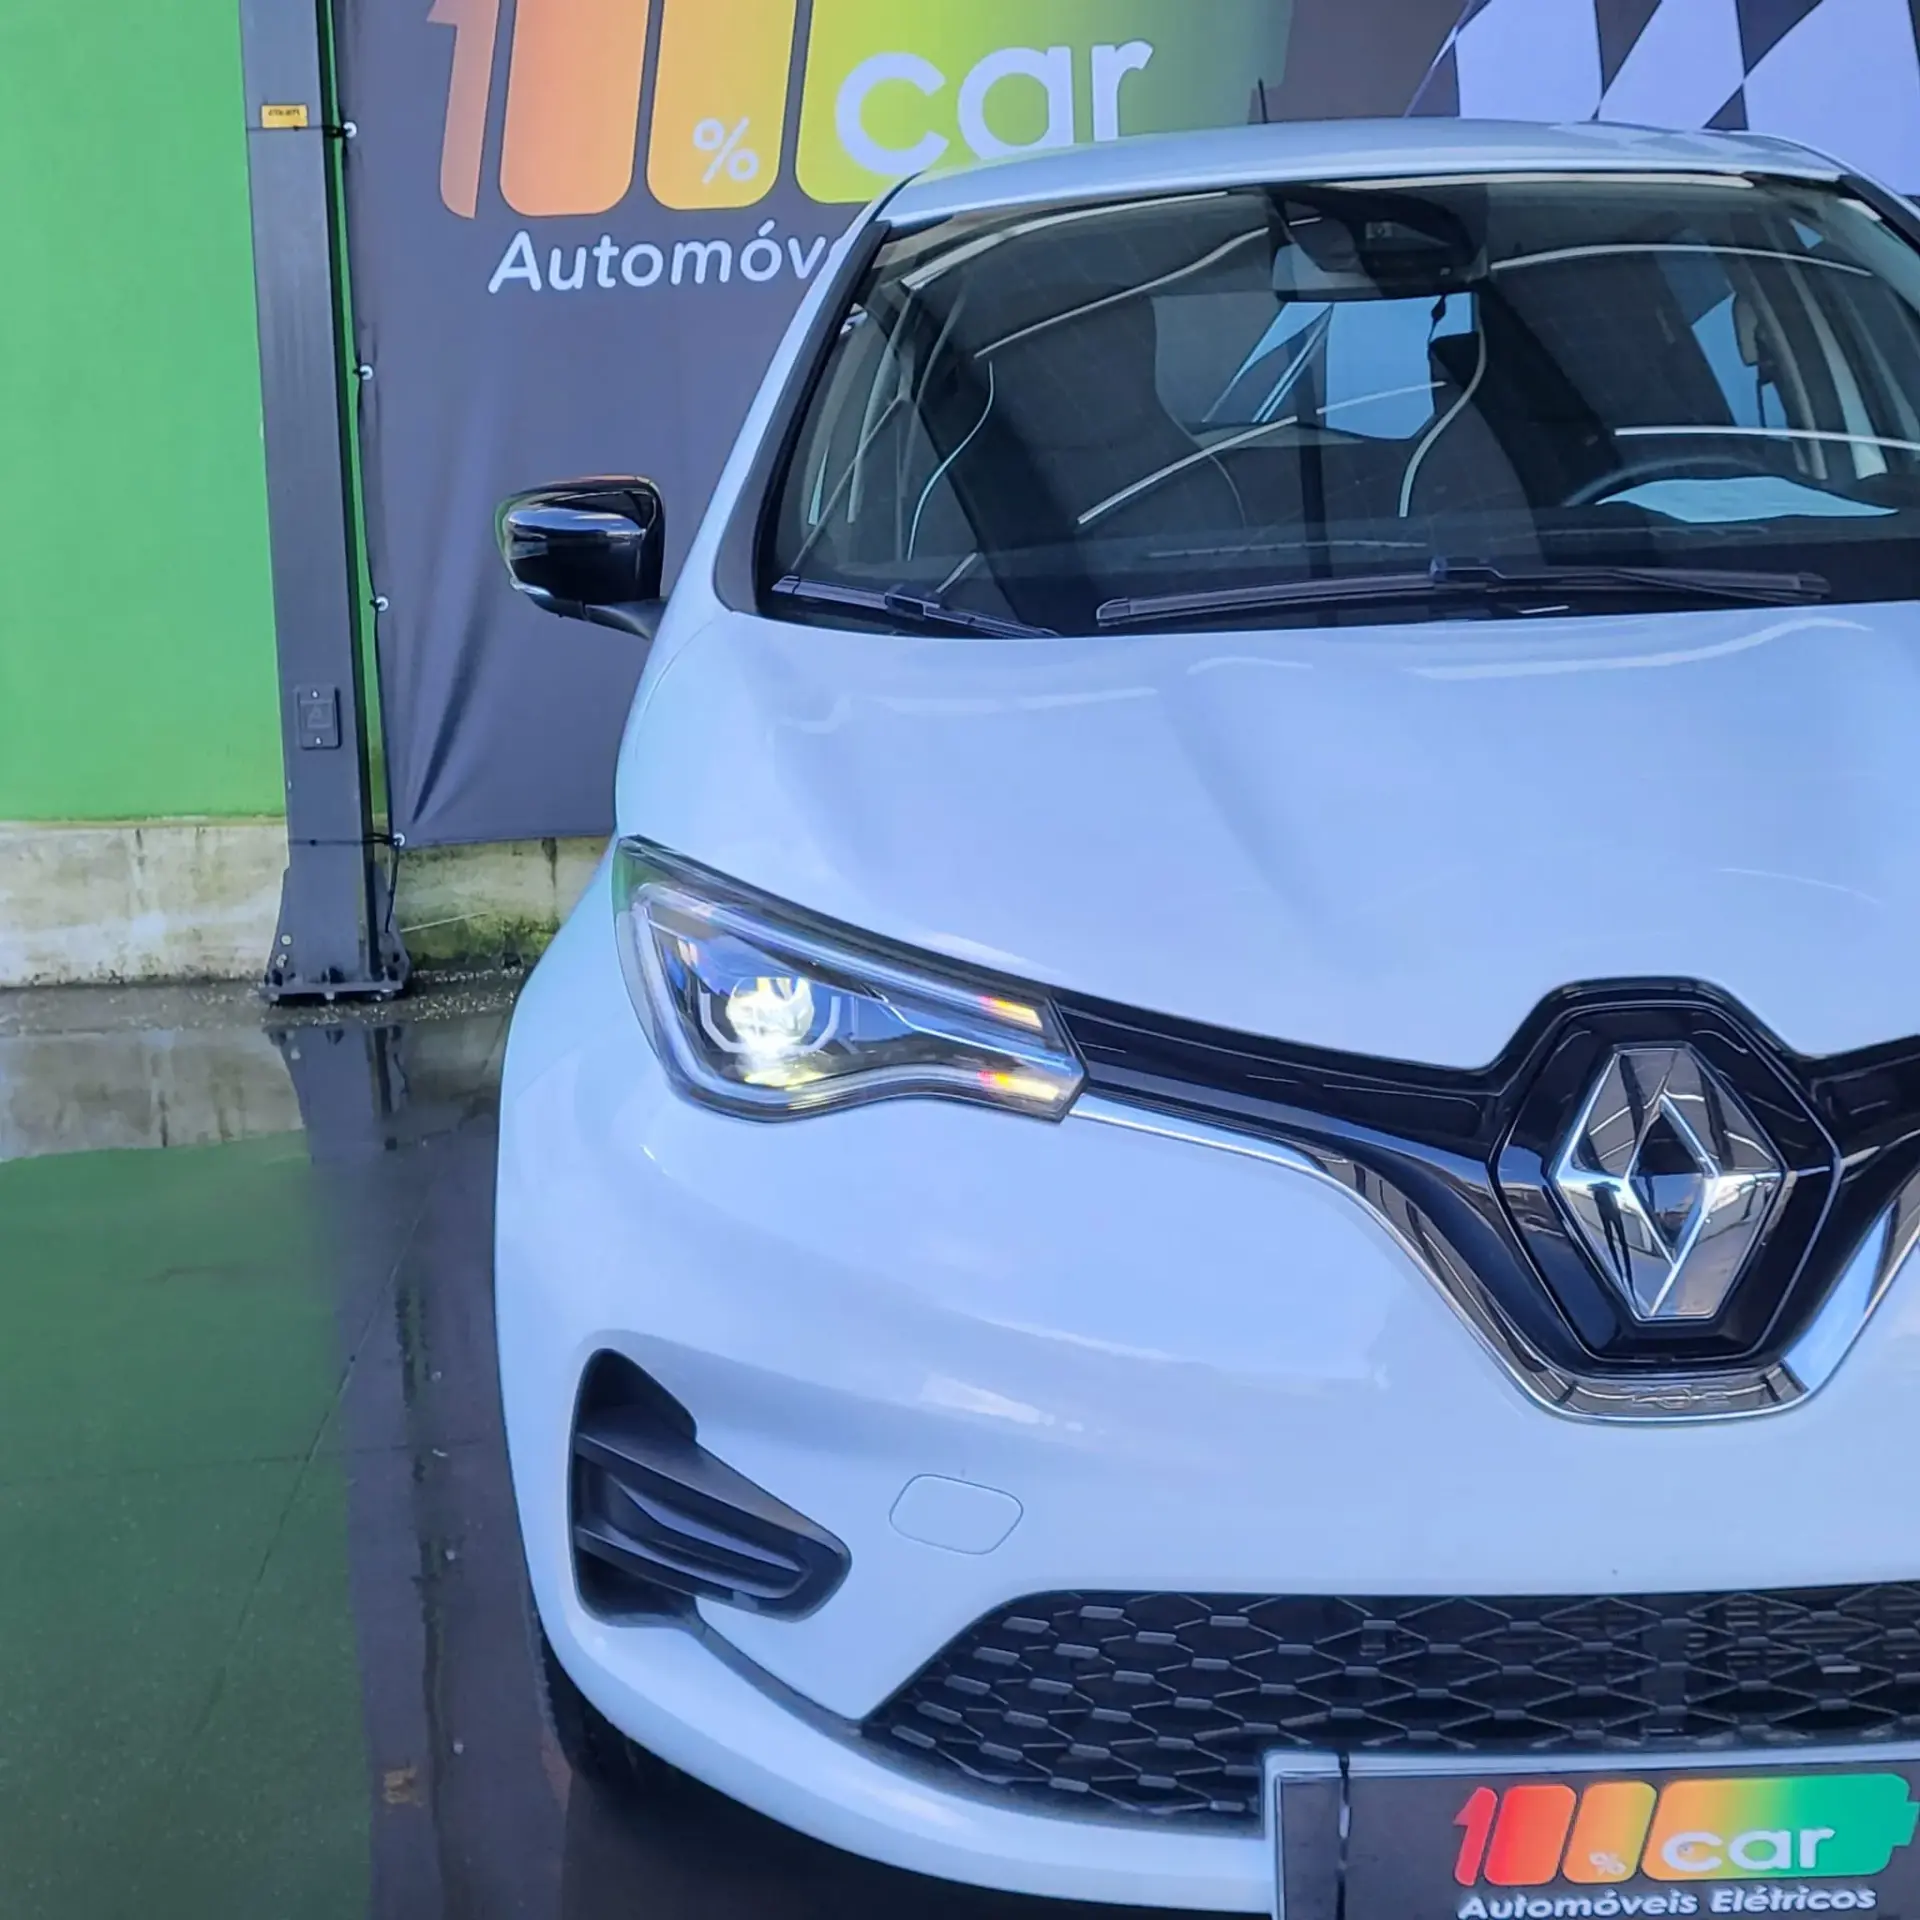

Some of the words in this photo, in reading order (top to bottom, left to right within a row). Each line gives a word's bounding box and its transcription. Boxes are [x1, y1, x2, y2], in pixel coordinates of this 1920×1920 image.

[835, 40, 1153, 176] car
[487, 219, 836, 294] Automóv
[1661, 1827, 1835, 1872] car
[1457, 1889, 1698, 1919] Automóveis
[1710, 1884, 1877, 1913] Elétricos
